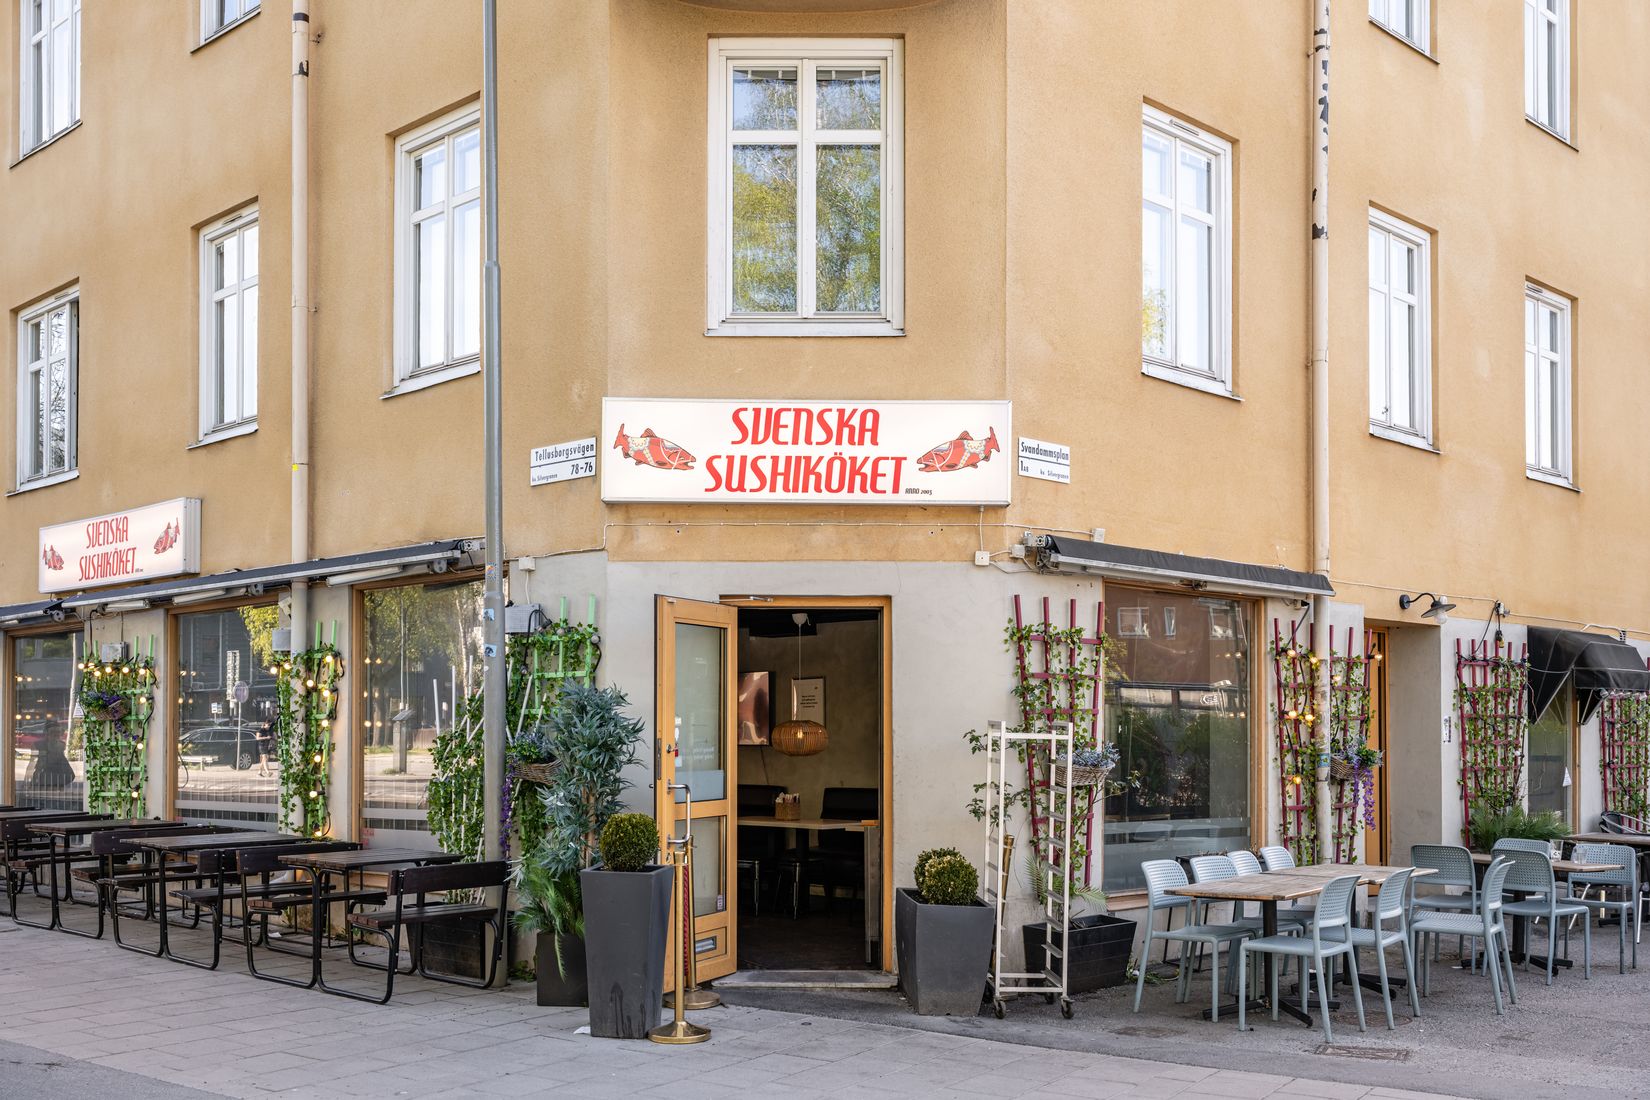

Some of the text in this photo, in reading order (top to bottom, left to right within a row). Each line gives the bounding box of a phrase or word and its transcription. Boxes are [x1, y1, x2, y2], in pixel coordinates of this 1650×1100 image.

[731, 408, 880, 446] SVENSKA
[535, 443, 594, 461] Tellusborgsvägen
[1021, 441, 1069, 461] Svandammsplan
[570, 461, 593, 475] 78-76
[705, 452, 907, 494] SUSHIKÖKET
[86, 515, 128, 548] SVENSKA
[78, 546, 137, 581] SUSHIKÖKET
